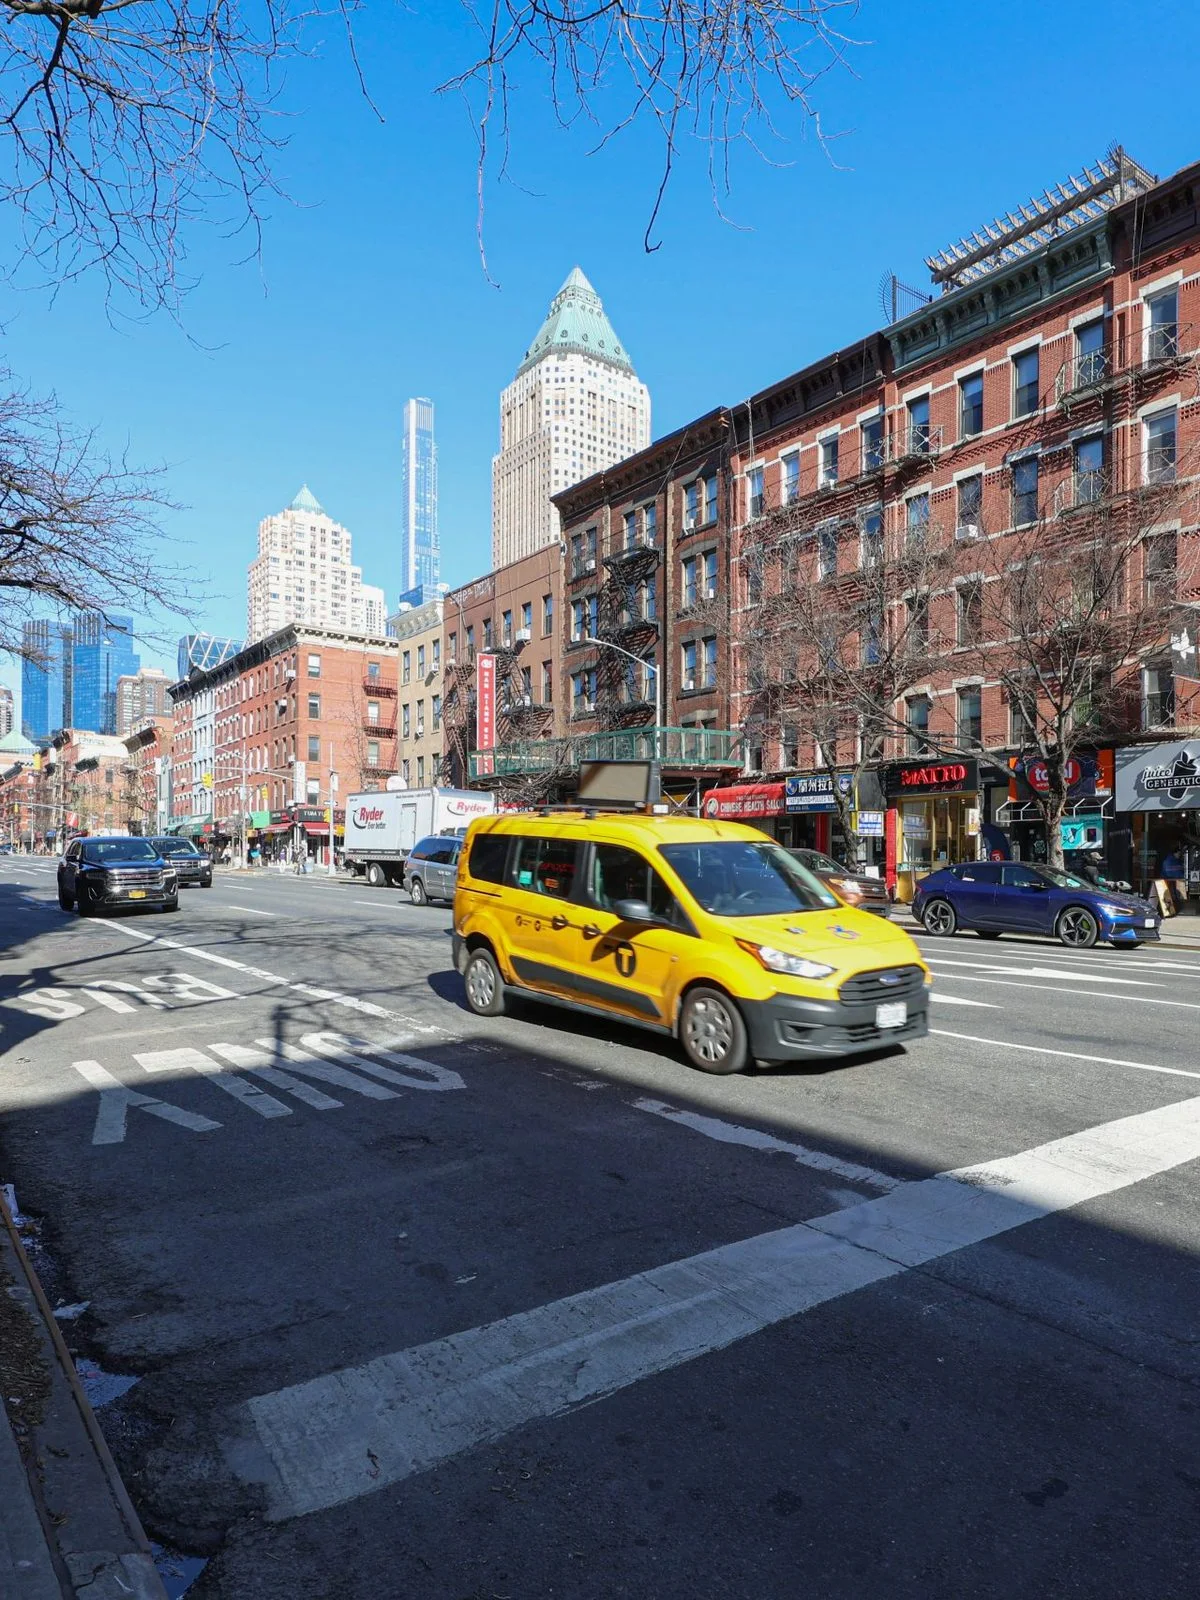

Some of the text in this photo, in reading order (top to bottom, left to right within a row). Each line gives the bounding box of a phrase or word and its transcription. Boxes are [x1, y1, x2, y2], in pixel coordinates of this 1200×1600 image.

[901, 765, 967, 786] MATTO
[1035, 762, 1073, 781] tol
[1141, 767, 1172, 782] juice
[359, 806, 384, 824] Ryder
[456, 802, 488, 813] Ryder
[720, 801, 743, 813] CHINESE
[744, 800, 765, 812] HEALTH
[17, 972, 239, 1020] BUS
[72, 1032, 467, 1145] ONLY
